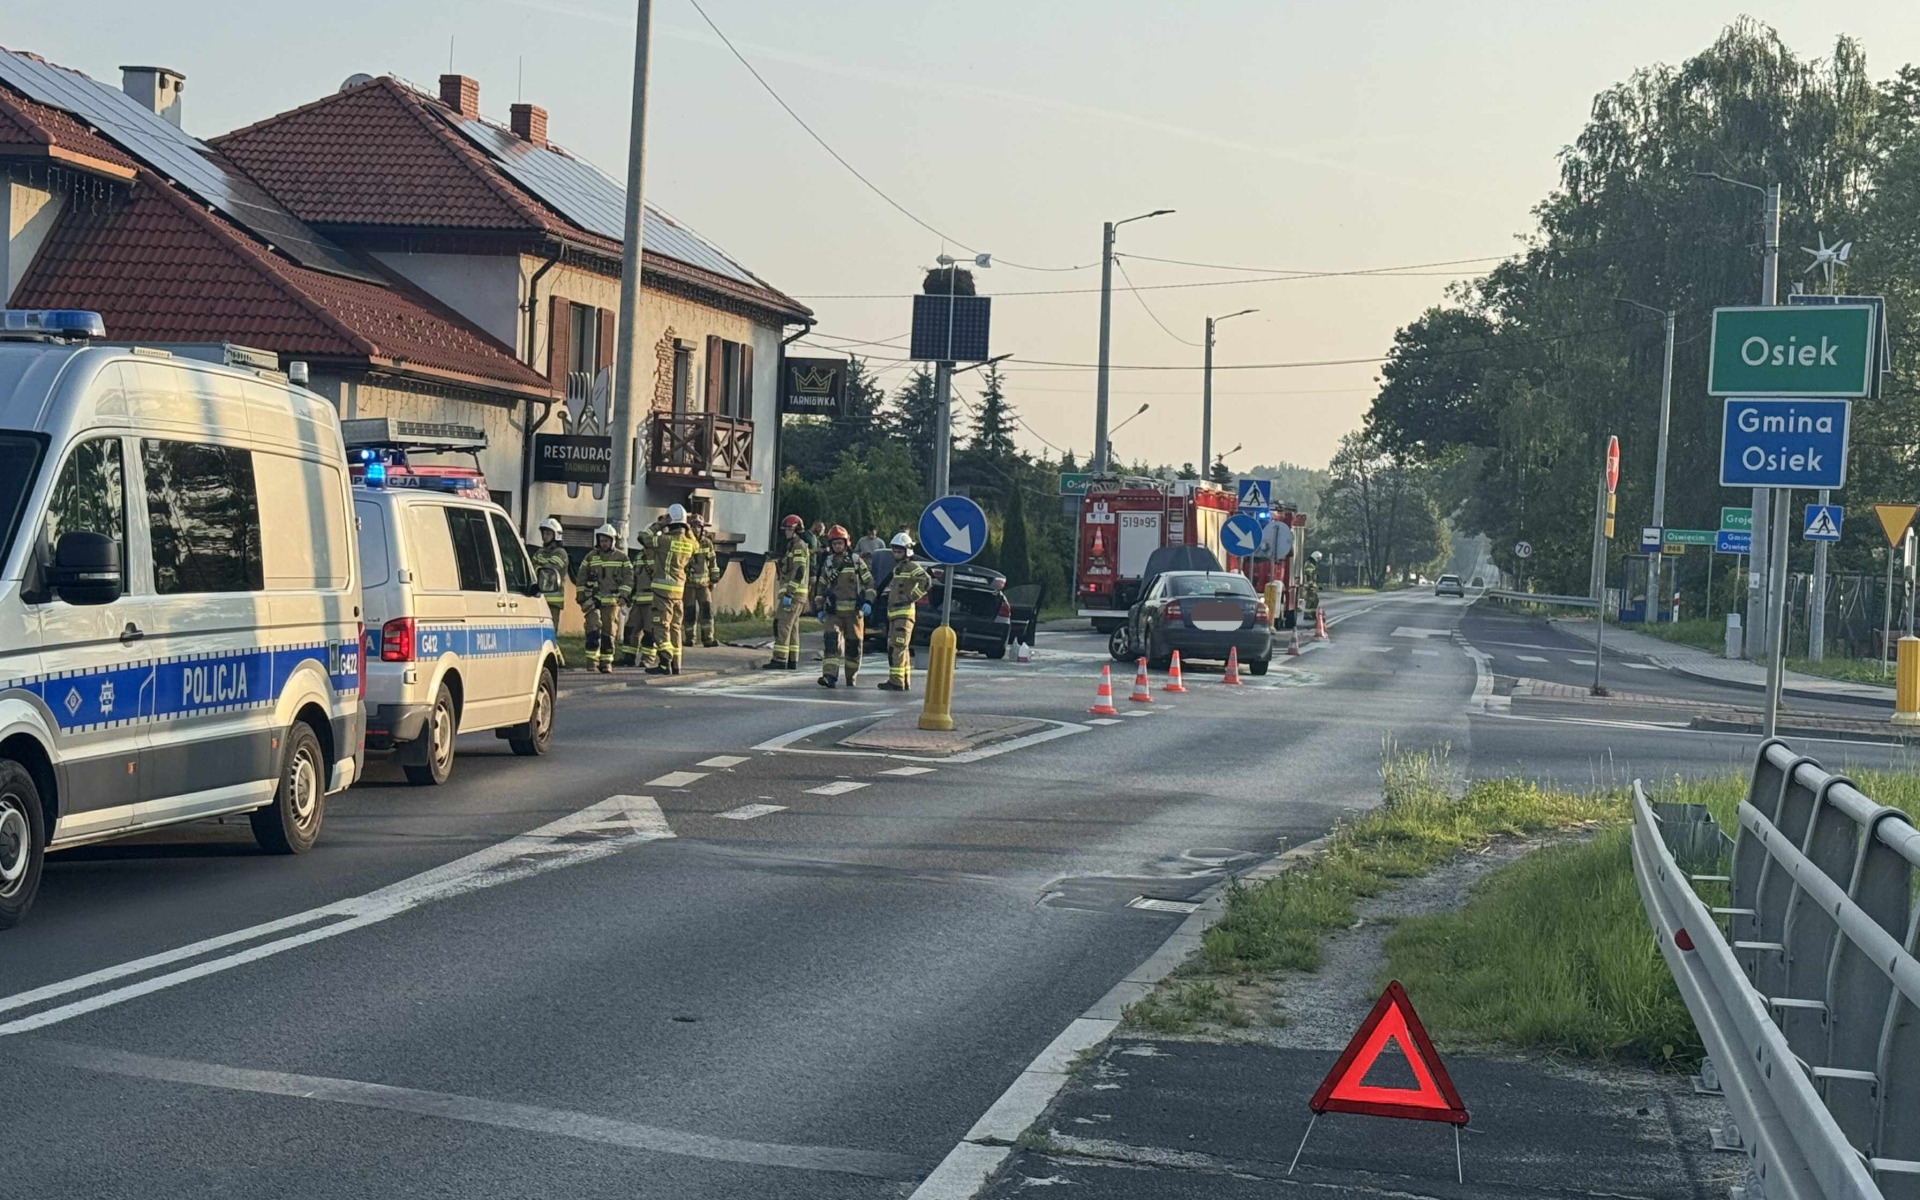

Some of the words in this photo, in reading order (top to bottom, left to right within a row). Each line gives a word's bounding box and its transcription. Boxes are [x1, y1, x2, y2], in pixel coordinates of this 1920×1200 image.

[1741, 336, 1839, 366] Osiek
[1738, 408, 1832, 433] Gmina
[1742, 446, 1823, 471] Osiek
[354, 477, 418, 486] PCJA
[1517, 543, 1530, 555] 70
[422, 634, 438, 653] G412
[476, 632, 497, 651] POLICJA
[340, 653, 358, 675] G422
[182, 662, 248, 706] POLICJA
